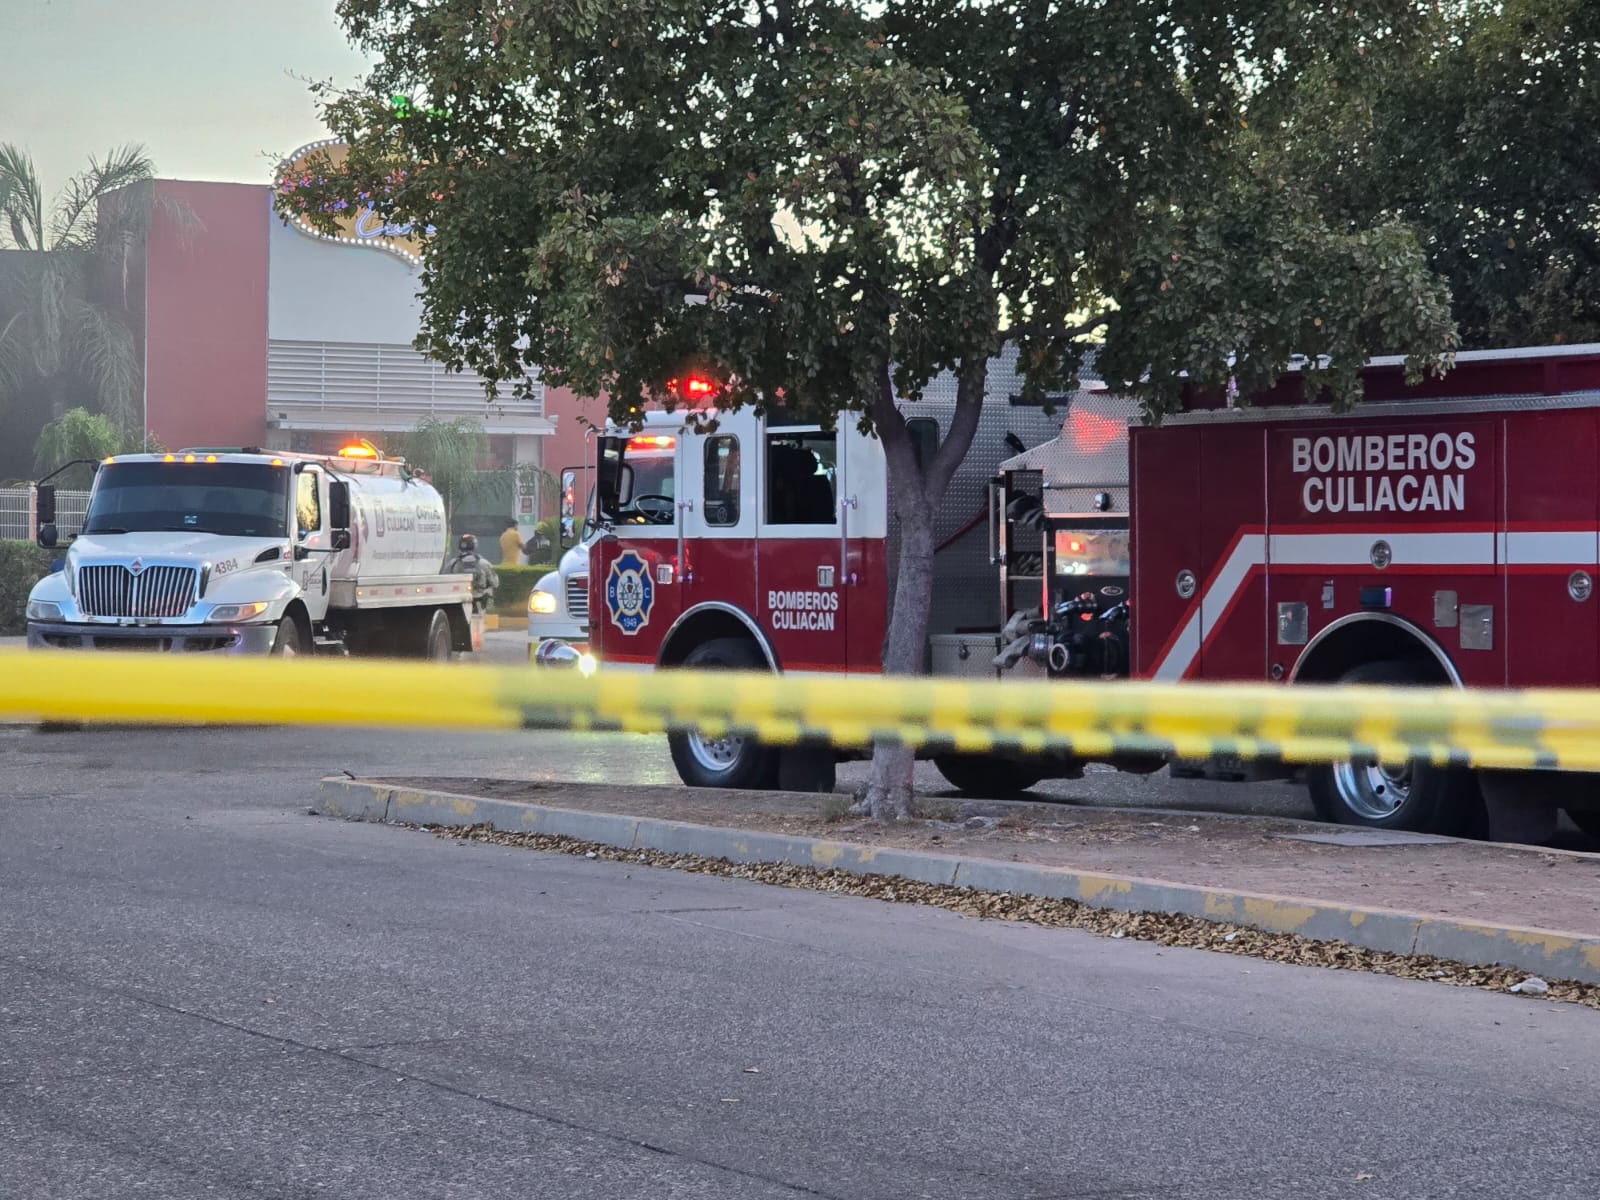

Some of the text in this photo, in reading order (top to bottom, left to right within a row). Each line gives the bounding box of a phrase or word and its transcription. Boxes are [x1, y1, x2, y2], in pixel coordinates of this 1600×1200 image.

[1292, 431, 1476, 473] BOMBEROS
[1303, 474, 1465, 513] CULIACAN
[215, 558, 238, 575] 4384
[644, 587, 650, 599] C
[768, 590, 839, 611] BOMBEROS
[772, 610, 834, 631] CULIACAN
